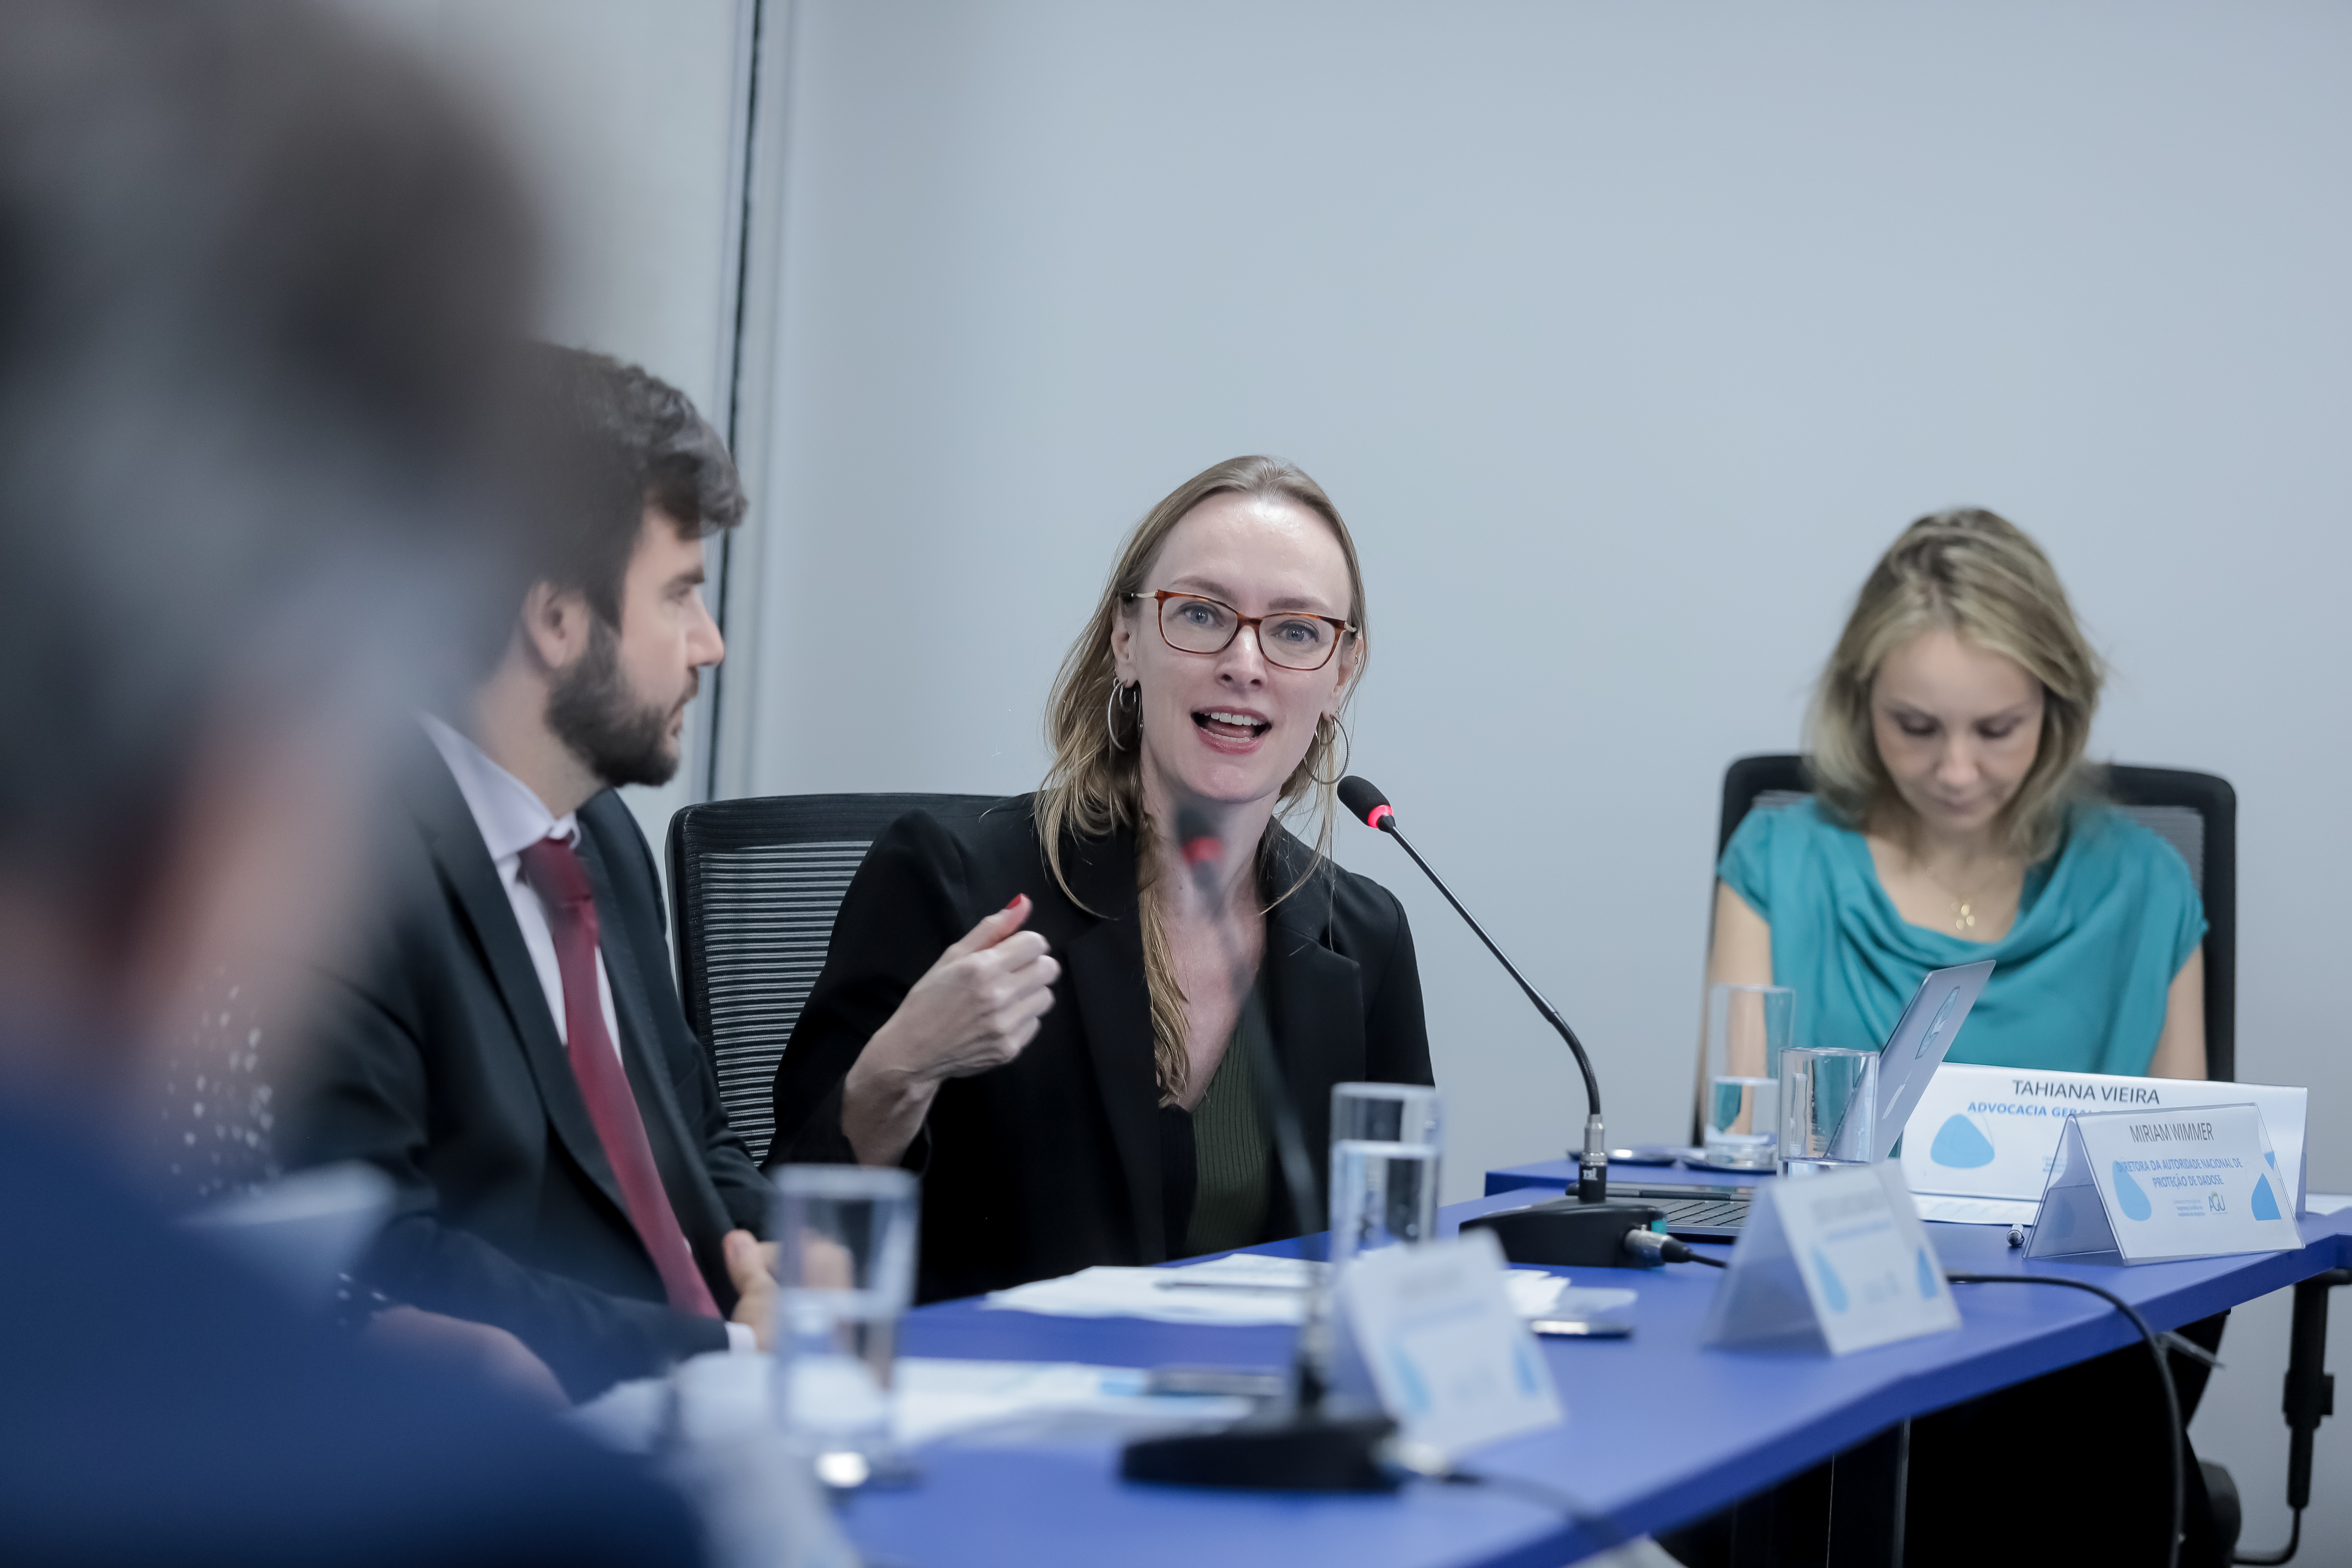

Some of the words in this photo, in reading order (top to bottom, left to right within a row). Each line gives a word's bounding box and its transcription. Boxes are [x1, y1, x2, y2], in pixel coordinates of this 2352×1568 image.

[2012, 1080, 2095, 1101] TAHIANA
[2101, 1086, 2160, 1104] VIEIRA
[1968, 1102, 2047, 1117] ADVOCACIA
[2129, 1124, 2172, 1143] MIRIAM
[2168, 1122, 2214, 1141] WIMMER
[2116, 1161, 2150, 1172] DIRETORA
[2149, 1160, 2162, 1171] DA
[2162, 1159, 2202, 1170] AUTORIDADE
[2200, 1158, 2234, 1169] NACIONAL
[2232, 1158, 2243, 1168] DE
[2152, 1173, 2188, 1190] PROTEÇÃO
[2187, 1175, 2198, 1186] DE
[2197, 1174, 2224, 1186] DADOSE
[2208, 1192, 2226, 1212] AGU
